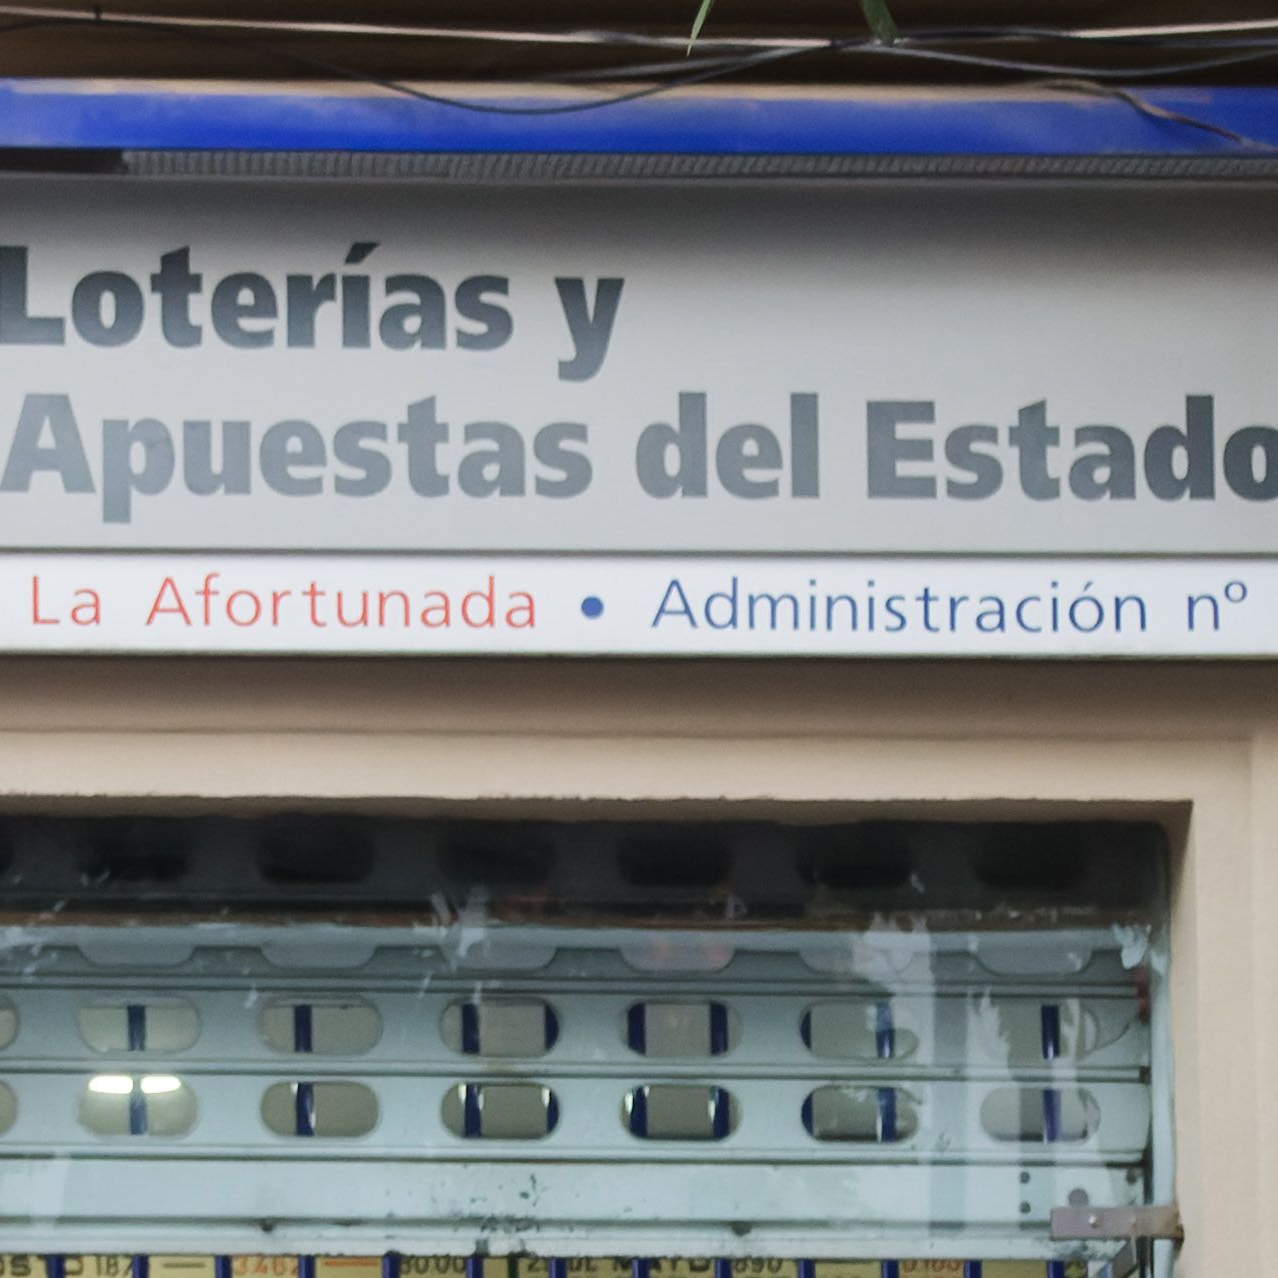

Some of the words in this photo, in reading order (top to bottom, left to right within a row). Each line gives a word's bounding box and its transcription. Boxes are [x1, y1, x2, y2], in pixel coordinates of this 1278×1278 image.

[555, 277, 625, 382] y
[636, 392, 820, 499] del
[31, 575, 101, 626] La
[146, 573, 536, 628] Afortunada
[652, 578, 1147, 633] Administración
